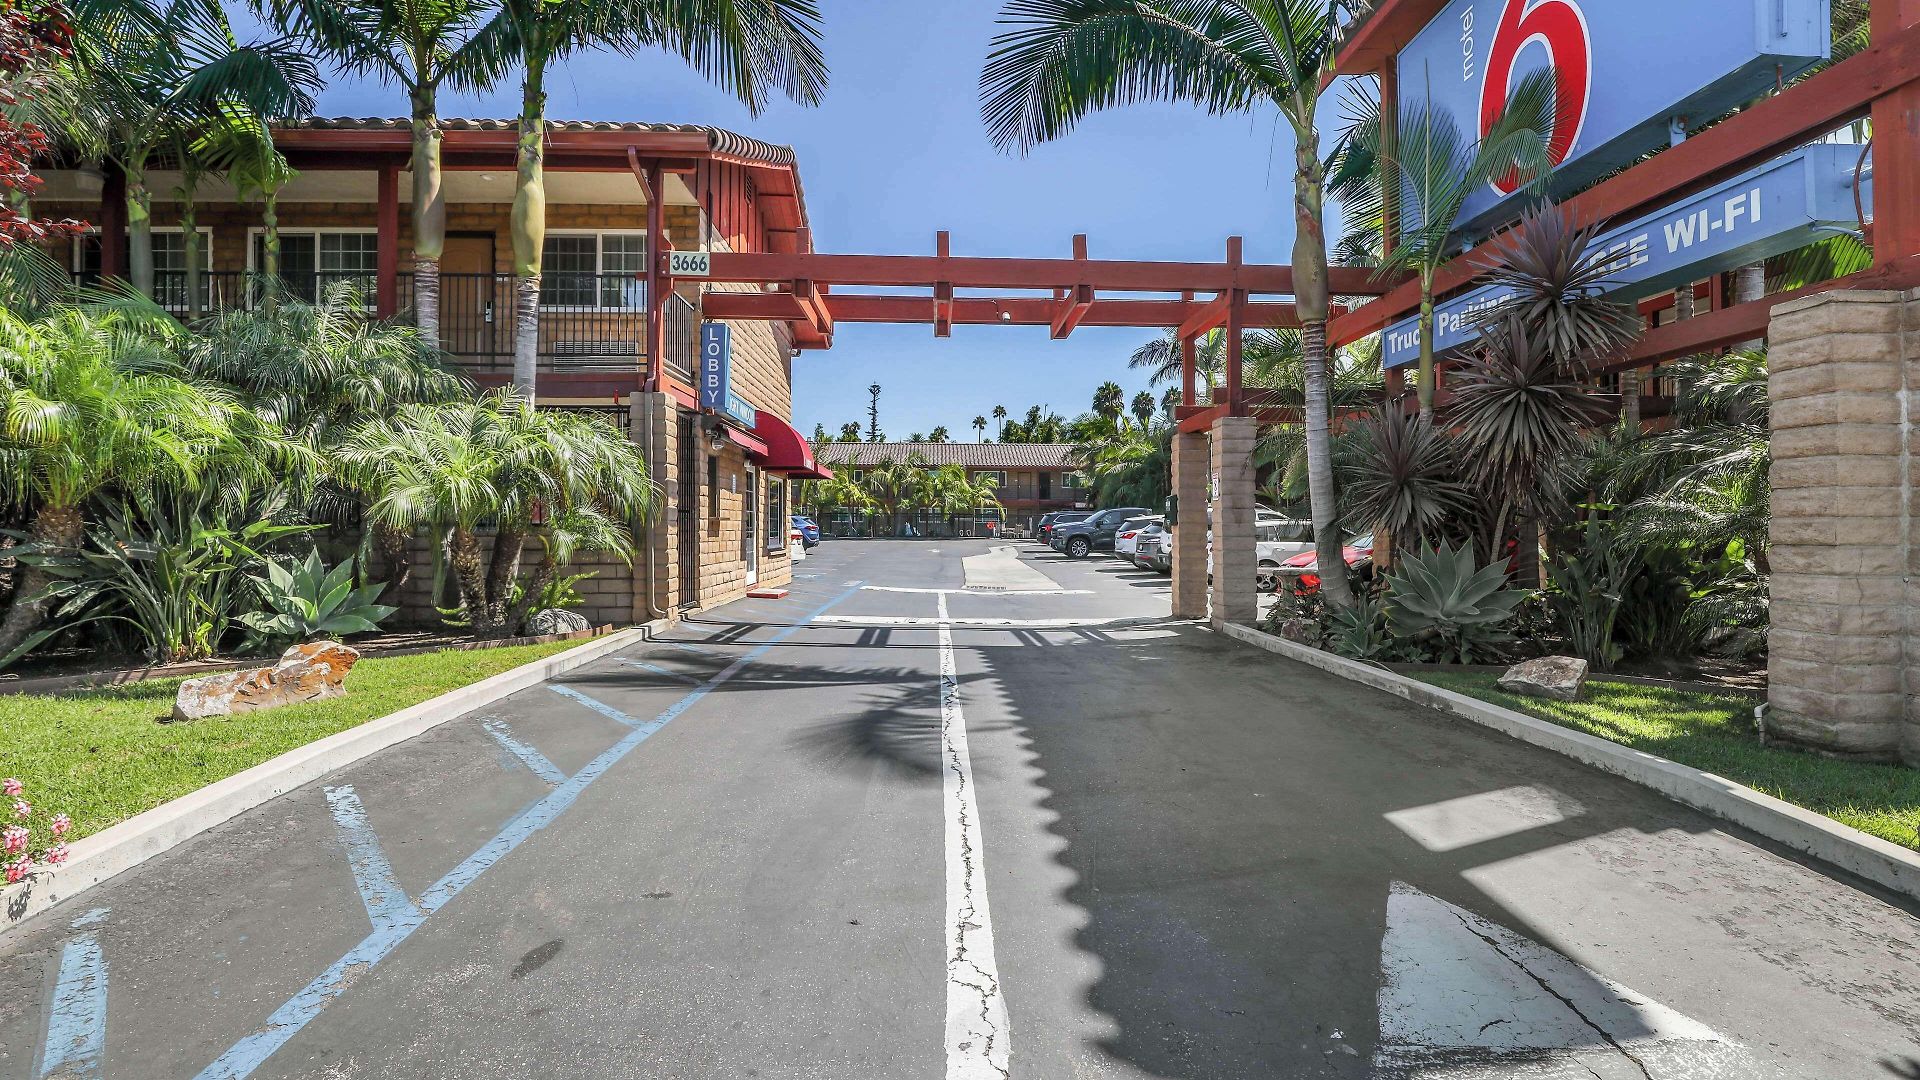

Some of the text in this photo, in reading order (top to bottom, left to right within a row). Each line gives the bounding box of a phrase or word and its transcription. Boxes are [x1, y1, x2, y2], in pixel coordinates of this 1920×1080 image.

[1460, 4, 1474, 82] motel
[1477, 0, 1592, 198] 6
[1663, 187, 1762, 254] WI-FI
[672, 254, 708, 272] 3666
[707, 327, 720, 403] LOBBY
[1388, 328, 1421, 354] Truc
